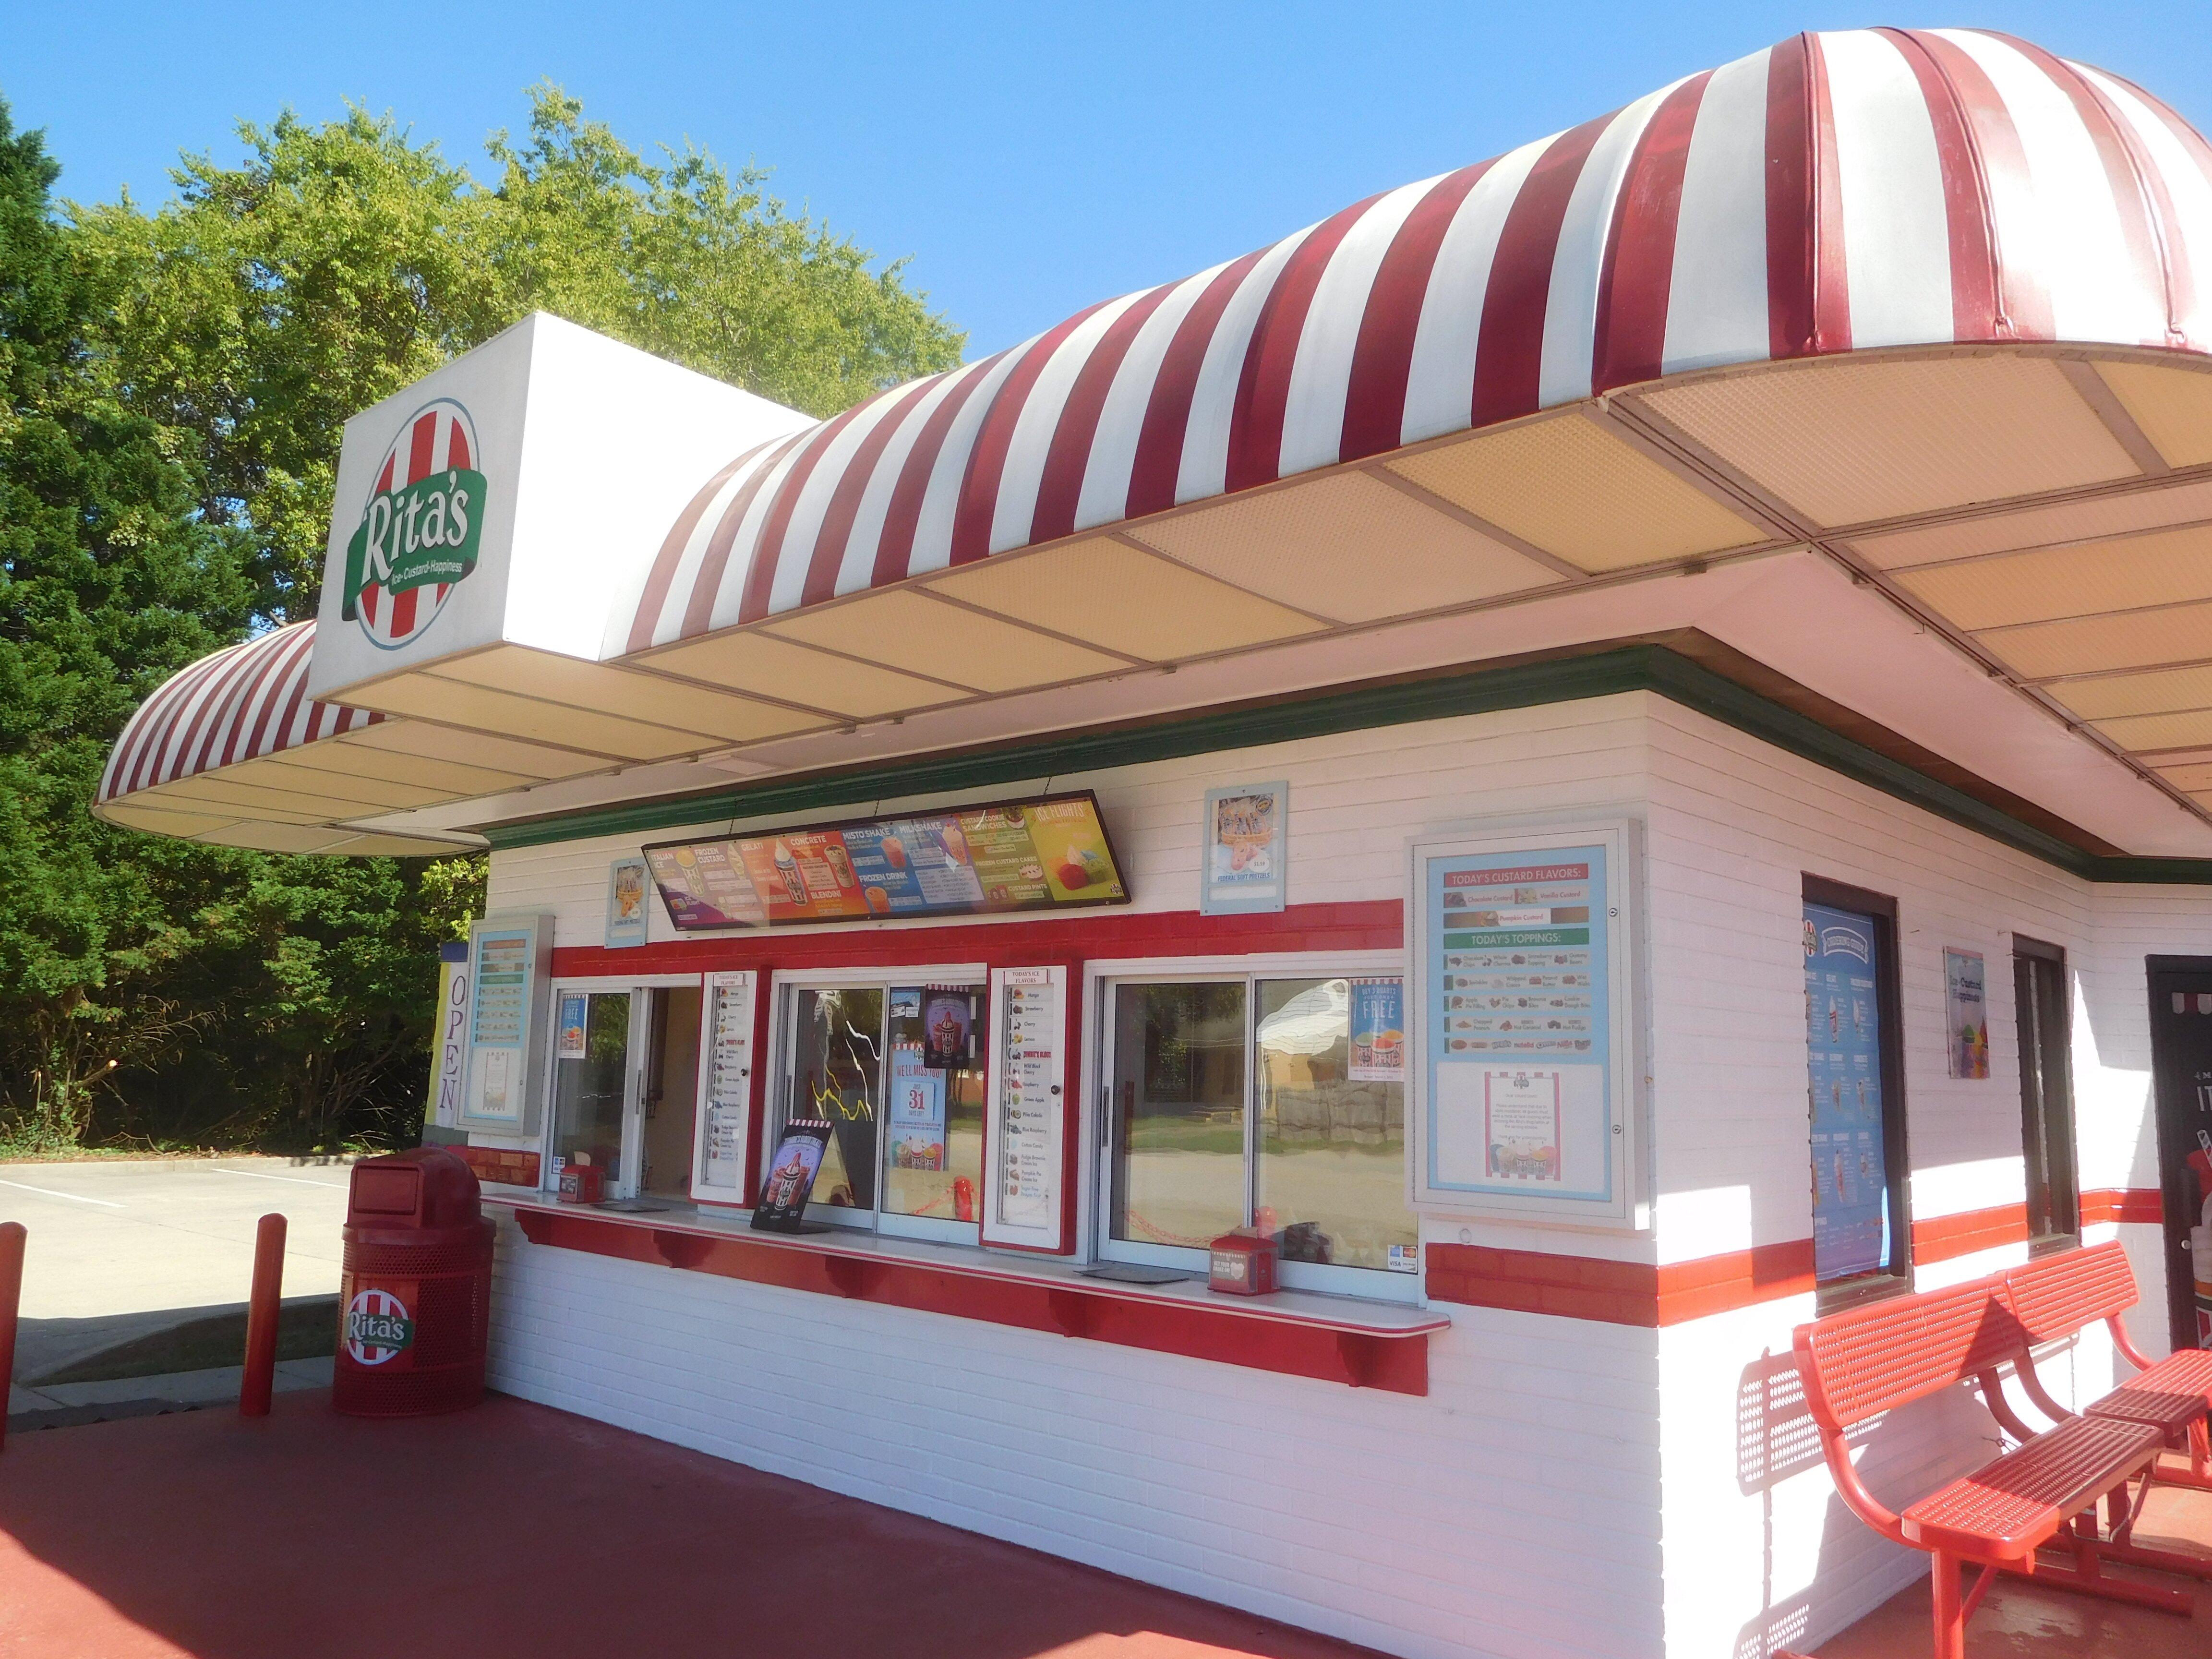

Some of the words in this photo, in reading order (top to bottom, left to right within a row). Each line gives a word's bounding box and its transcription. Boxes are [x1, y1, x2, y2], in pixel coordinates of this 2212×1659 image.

[361, 470, 469, 587] Rita's
[985, 814, 1005, 822] COOKIE
[1034, 806, 1049, 822] ICE
[1049, 803, 1084, 818] FLIGHTS
[898, 821, 942, 834] MILKSHAKE
[962, 821, 1007, 831] SANDWICHES
[790, 835, 827, 846] CONCRETE
[842, 830, 865, 840] MISTO
[866, 828, 890, 838] SHAKE
[694, 847, 719, 856] FROZEN
[741, 842, 764, 852] GELATI
[651, 853, 674, 861] ITALIAN
[697, 854, 725, 864] CUSTARD
[859, 874, 885, 882] FROZEN
[886, 871, 908, 879] DRINK
[1452, 873, 1489, 885] TODAY'S
[1492, 870, 1533, 882] CUSTARD
[1536, 868, 1581, 879] FLAVORS:
[1471, 935, 1510, 946] TODAY'S
[1512, 933, 1562, 944] TOPPINGS:
[1363, 1000, 1395, 1019] FREE
[439, 975, 467, 1111] OPEN
[914, 1064, 927, 1077] MISS
[909, 1089, 925, 1110] 31
[349, 1311, 405, 1341] Rita's
